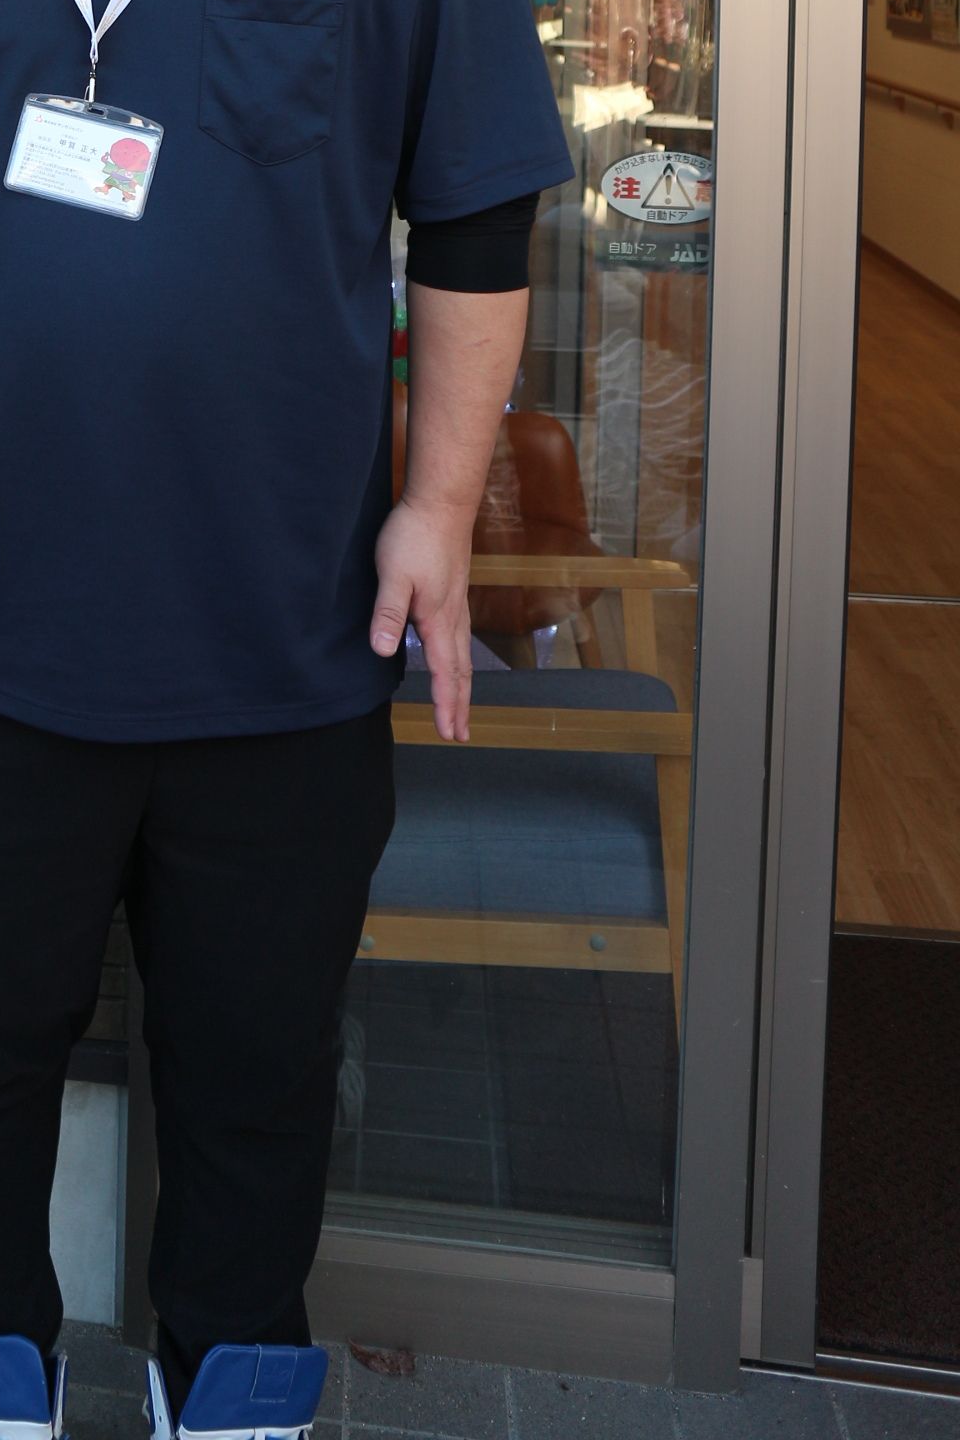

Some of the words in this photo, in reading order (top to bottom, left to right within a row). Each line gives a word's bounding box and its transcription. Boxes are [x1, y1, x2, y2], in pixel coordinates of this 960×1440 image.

[612, 176, 641, 200] 注
[646, 210, 688, 221] 自動ドア
[609, 242, 657, 255] 自動ドア
